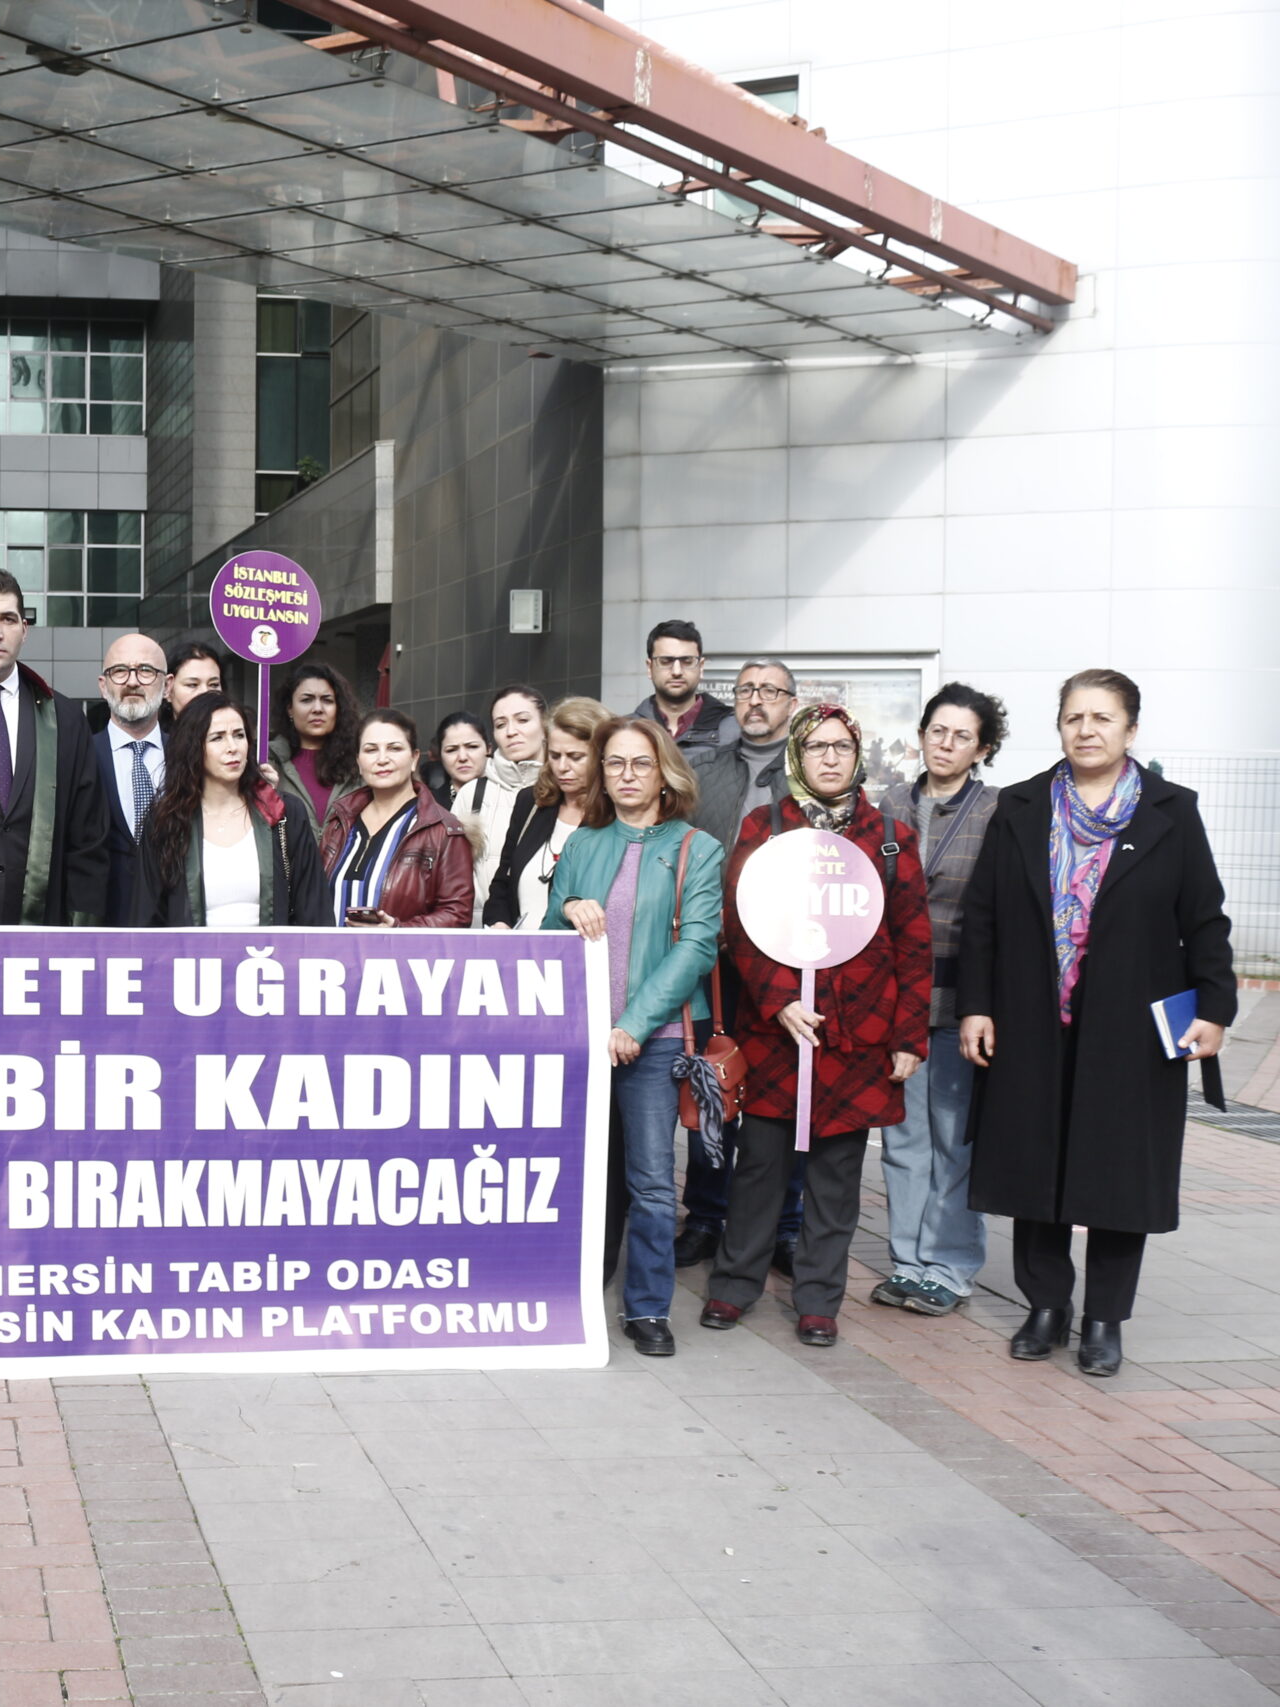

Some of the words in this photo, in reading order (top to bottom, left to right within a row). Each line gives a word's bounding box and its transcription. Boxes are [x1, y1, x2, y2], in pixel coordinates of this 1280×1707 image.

[224, 582, 308, 607] SÖZLEŞMESİ
[233, 563, 300, 586] İSTANBUL
[223, 603, 309, 625] UYGULANSIN
[173, 946, 565, 1017] UĞRAYAN
[195, 1054, 564, 1131] KADINI
[8, 1144, 560, 1229] BIRAKMAYACAĞIZ
[169, 1253, 311, 1293] TABİP
[327, 1258, 469, 1291] ODASI
[92, 1307, 244, 1341] KADIN
[261, 1301, 548, 1338] PLATFORMU
